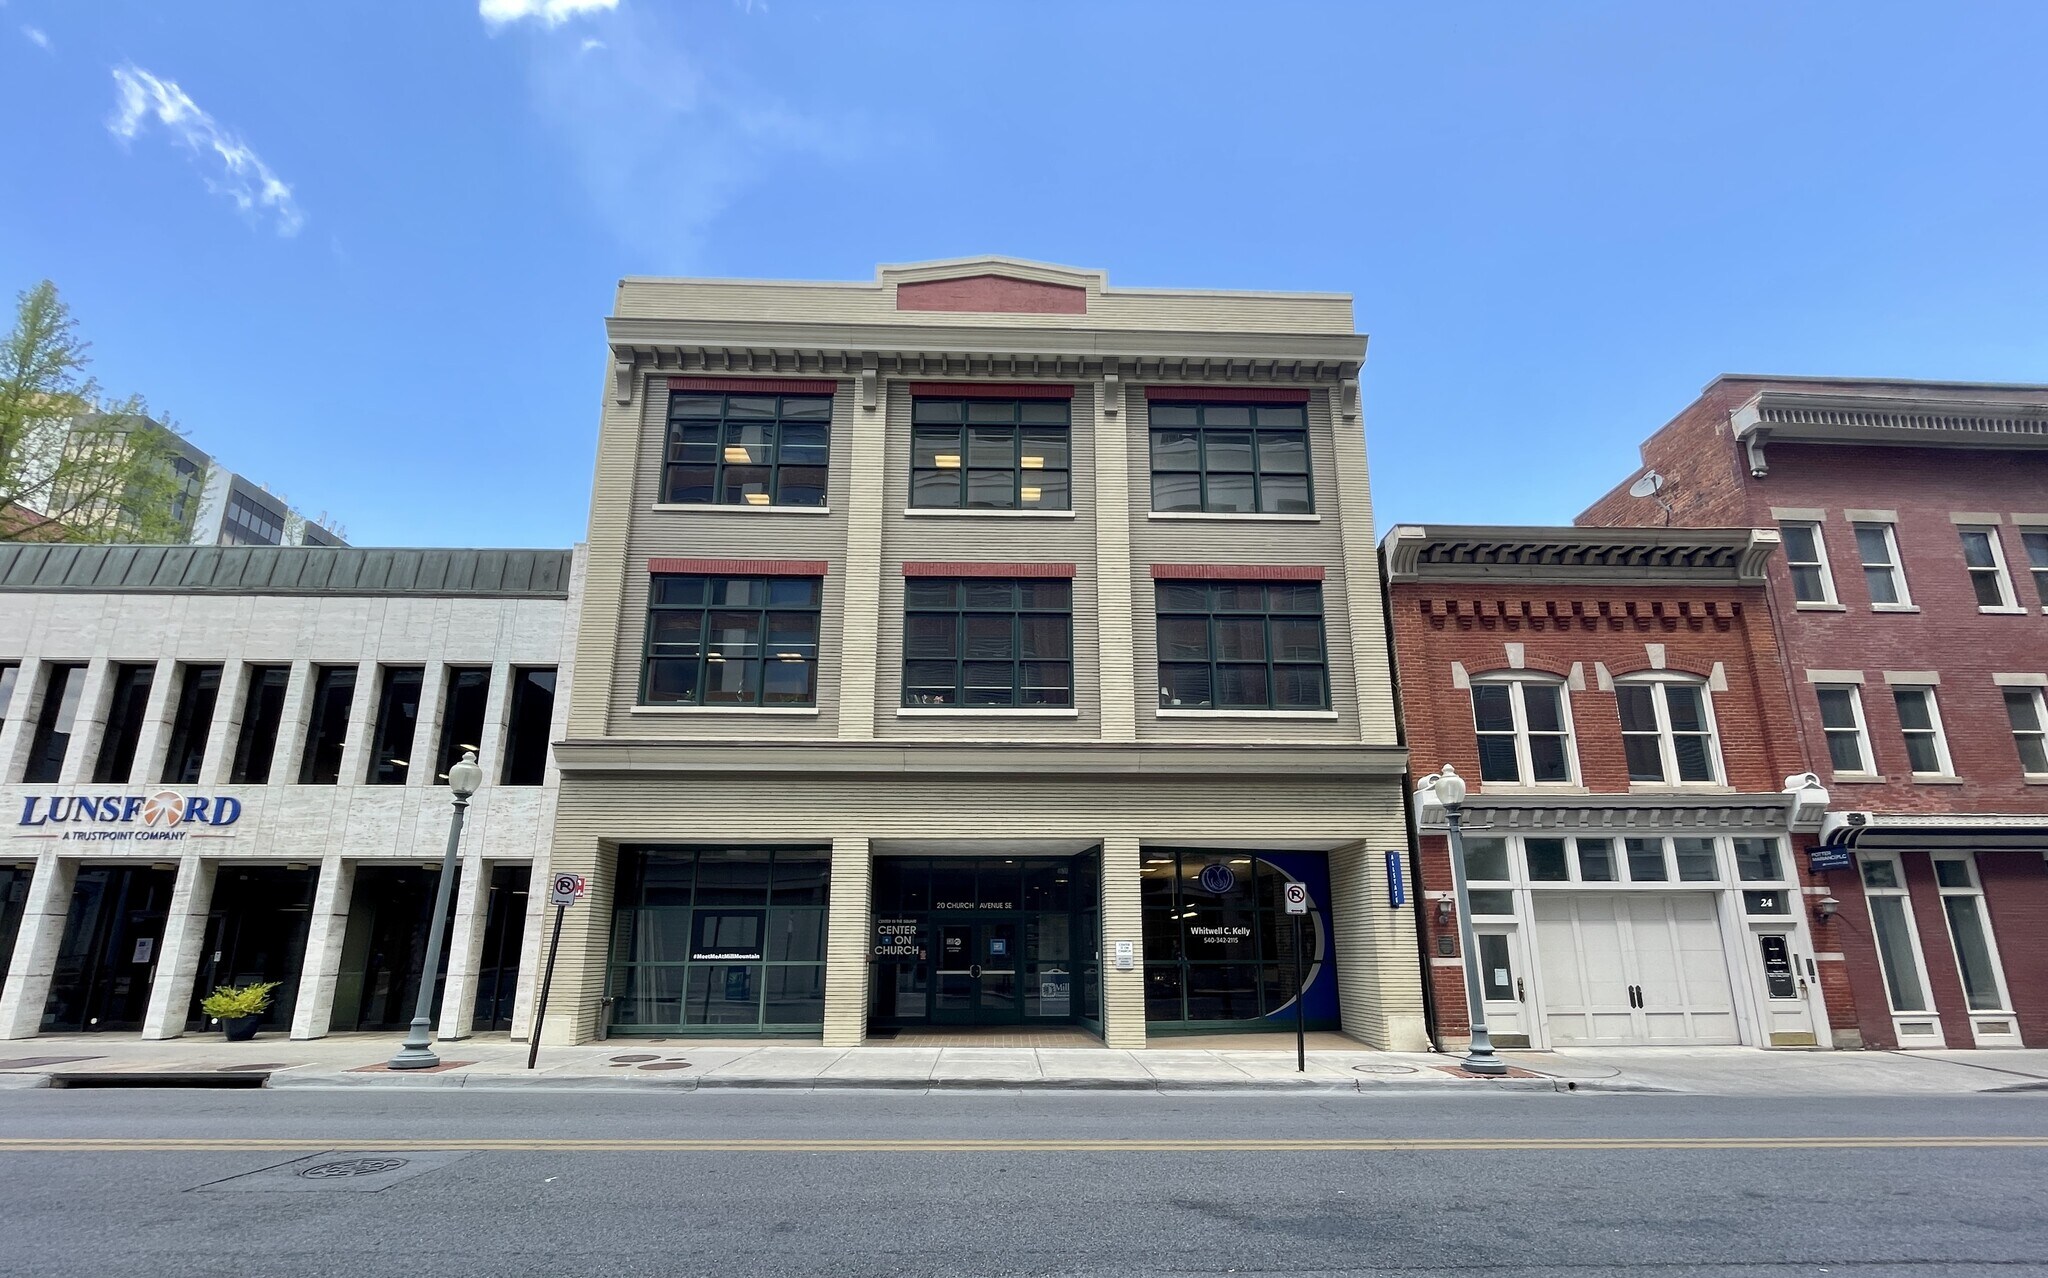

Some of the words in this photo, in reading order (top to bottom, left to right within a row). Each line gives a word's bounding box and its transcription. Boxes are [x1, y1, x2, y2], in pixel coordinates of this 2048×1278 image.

[62, 832, 69, 840] A
[72, 831, 133, 841] TRUSTPOINT
[135, 831, 186, 841] COMPANY
[1761, 899, 1773, 907] 24
[877, 925, 917, 935] CENTER
[1190, 926, 1222, 935] Whitwell
[1224, 927, 1231, 935] C.
[1232, 926, 1251, 937] Kelly
[894, 935, 912, 945] ON
[874, 945, 919, 955] CHURCH
[1055, 983, 1069, 991] Mill
